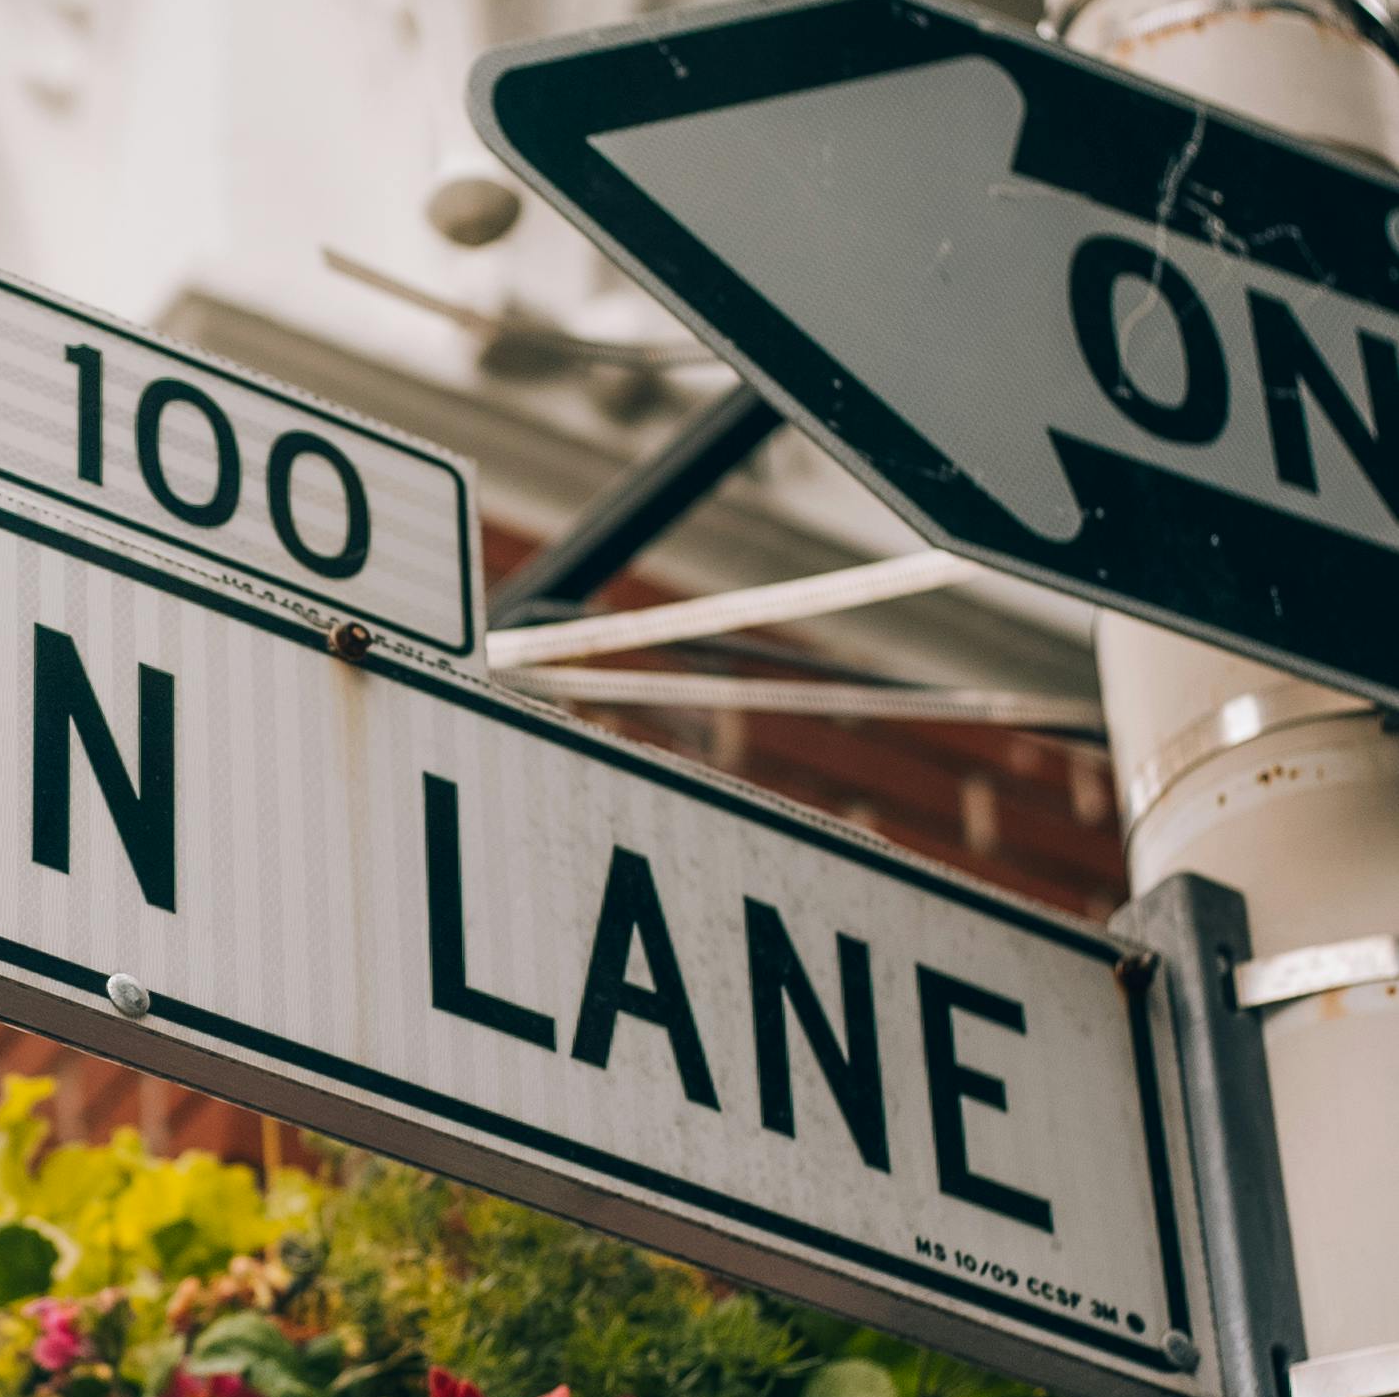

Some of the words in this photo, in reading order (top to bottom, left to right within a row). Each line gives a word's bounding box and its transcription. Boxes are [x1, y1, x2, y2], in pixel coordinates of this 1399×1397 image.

[65, 343, 371, 580] 100
[423, 772, 1054, 1235] LANE
[954, 1250, 1019, 1288] 10/09
